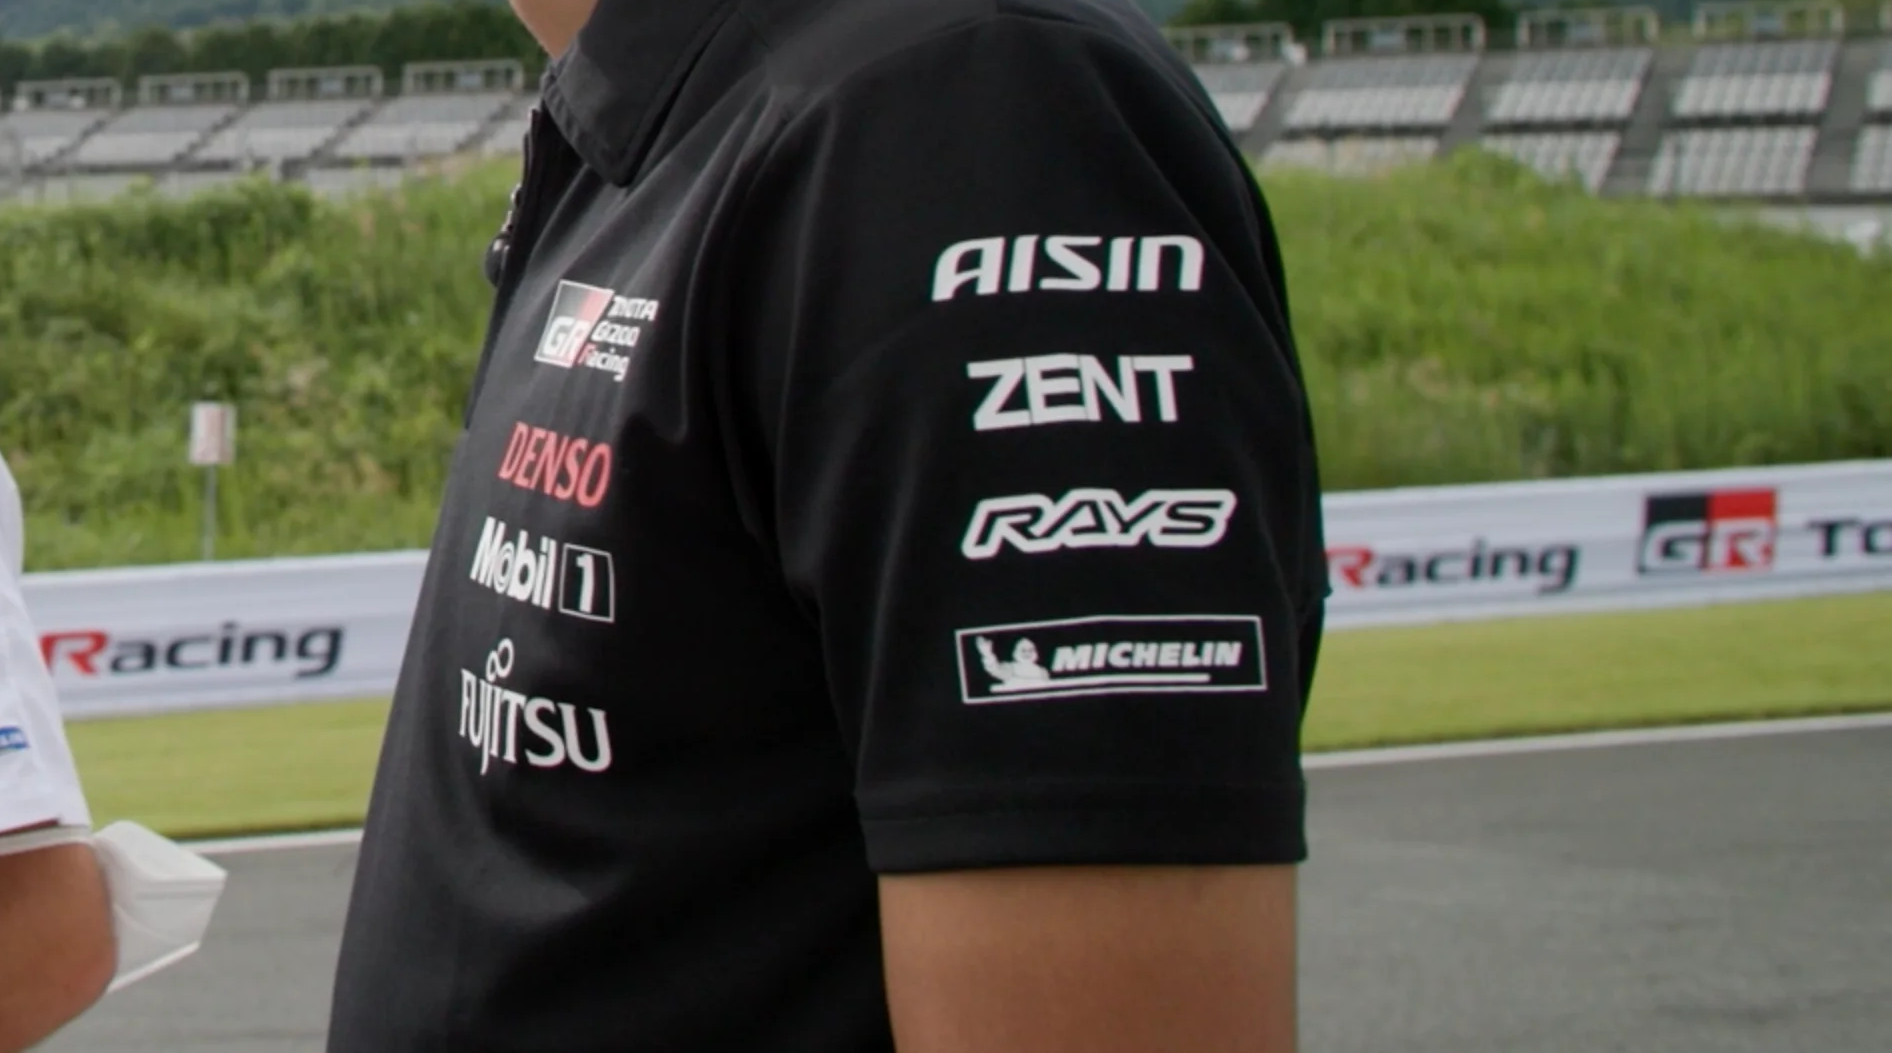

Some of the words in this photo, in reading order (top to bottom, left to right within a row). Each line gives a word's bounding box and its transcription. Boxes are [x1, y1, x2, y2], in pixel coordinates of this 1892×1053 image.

[932, 234, 1205, 302] AISIN
[967, 353, 1194, 431] ZENT
[497, 421, 613, 508] DENSO
[961, 488, 1237, 560] RAYS
[469, 516, 557, 610] Mobil
[1325, 539, 1580, 597] Racing
[38, 621, 343, 679] Racing
[1051, 640, 1242, 673] MICHELIN
[459, 667, 613, 776] FUJITSU
